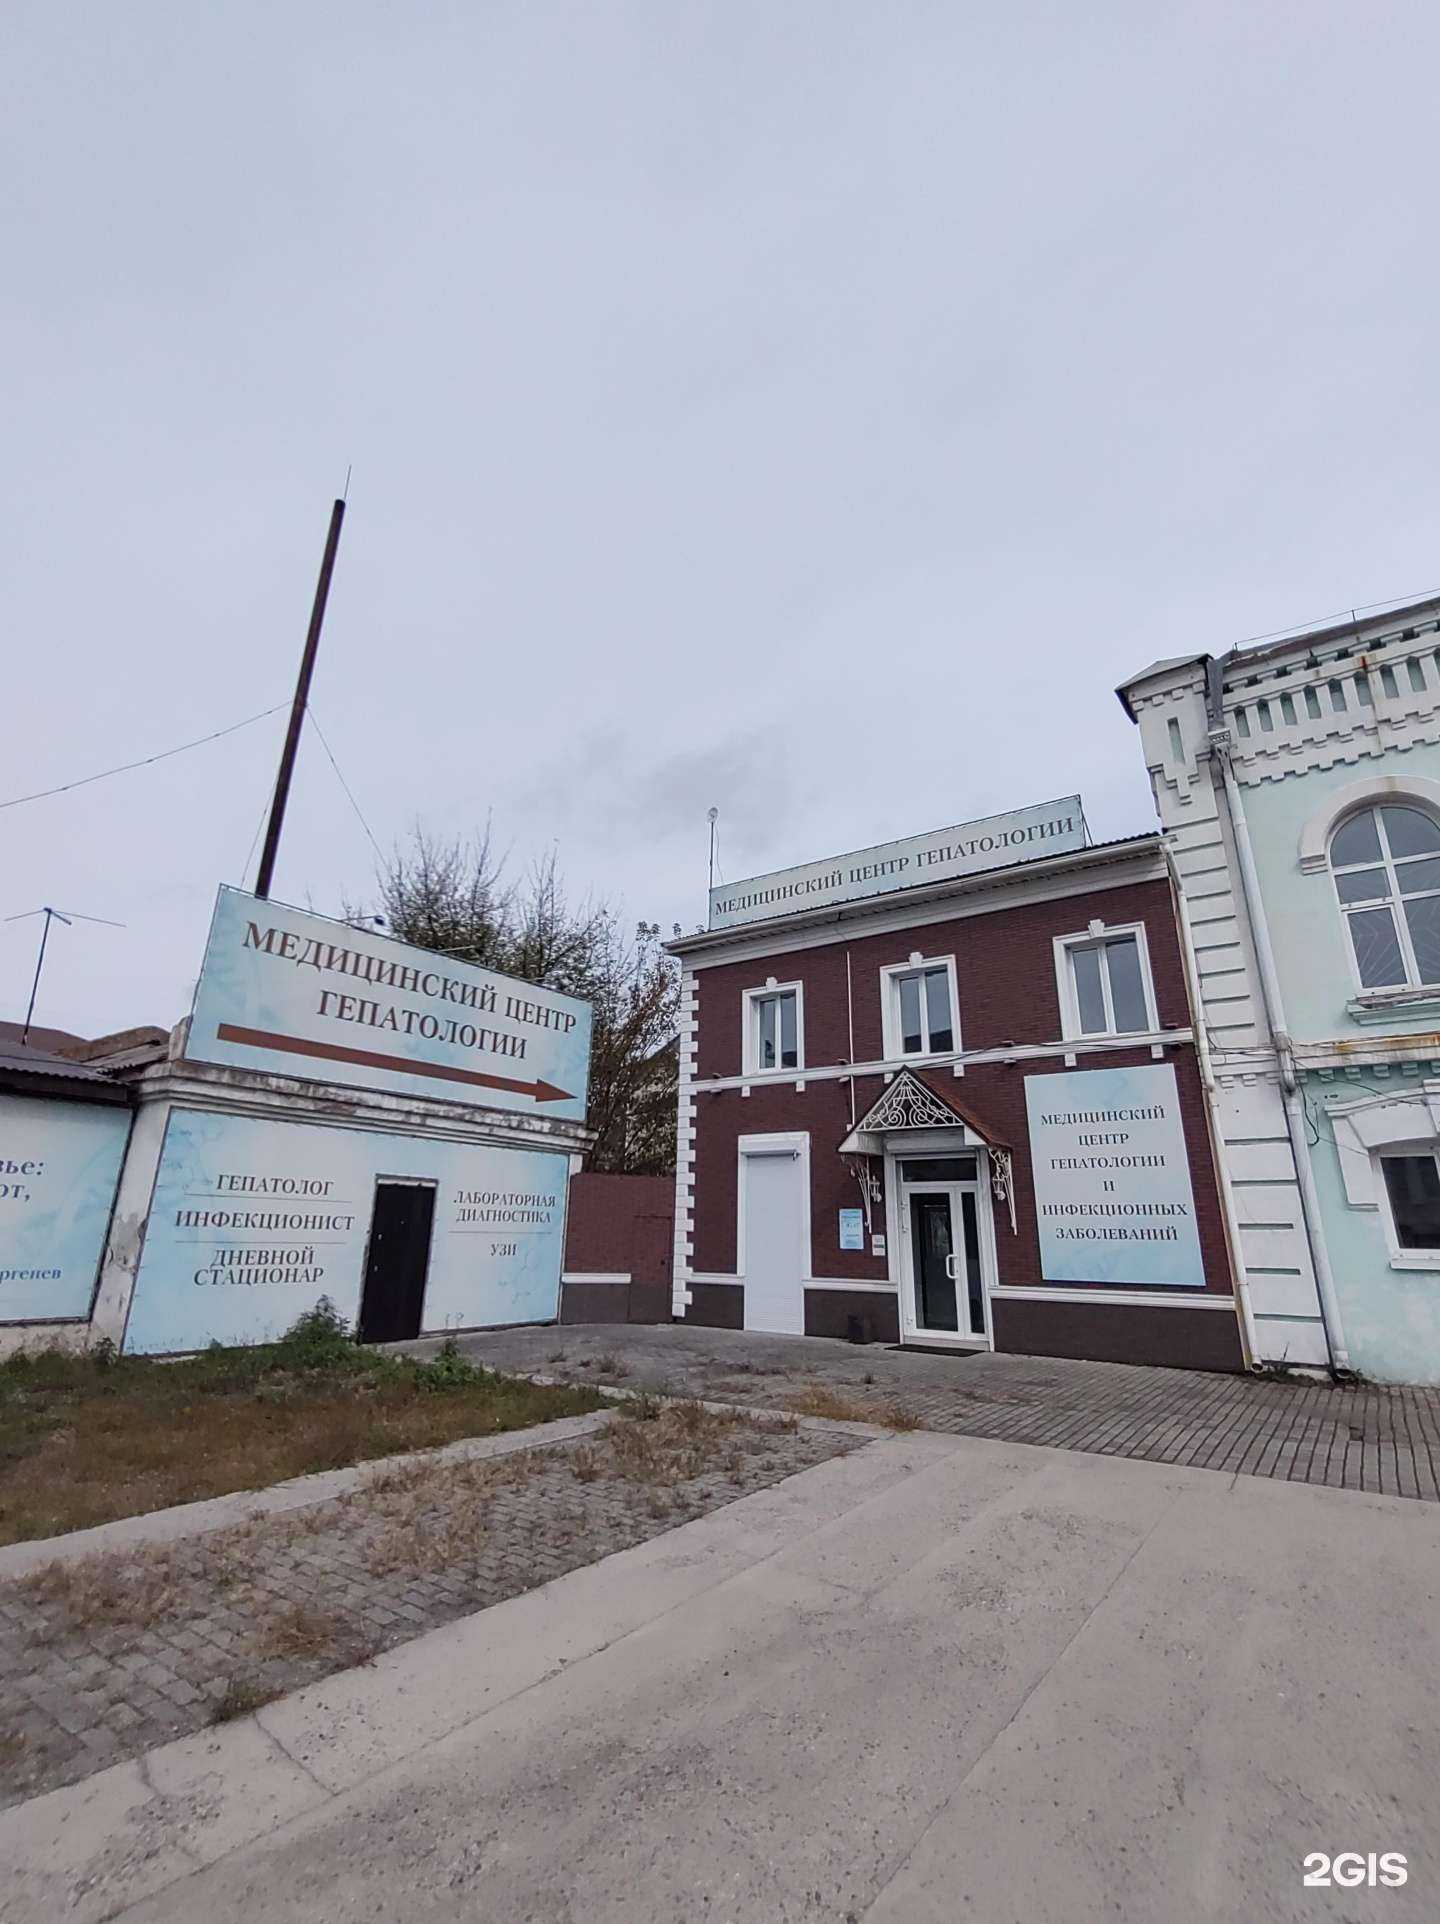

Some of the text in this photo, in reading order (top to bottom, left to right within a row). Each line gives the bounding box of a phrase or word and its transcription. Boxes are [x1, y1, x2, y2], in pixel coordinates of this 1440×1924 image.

[715, 816, 1074, 916] МЕДИЦИНСКИЙ ЦЕНТР ГЕПАТОЛОГИИ
[243, 920, 577, 1035] МЕДИЦИНСКИЙ ЦЕНТР
[316, 990, 528, 1060] ГЕПАТОЛОГИИ
[1041, 1105, 1165, 1126] МЕДИЦИНСКИЙ
[1078, 1133, 1129, 1147] ЦЕНТР
[1050, 1155, 1165, 1170] ГЕПАТОЛОГИИ
[216, 1174, 334, 1196] ГЕПАТОЛОГ
[1103, 1180, 1115, 1192] И
[453, 1190, 556, 1207] ЛАБОРАТОРНАЯ
[456, 1208, 551, 1223] ДИАГНОСТИКА
[1042, 1203, 1188, 1217] ИНФЕКЦИОННЫХ
[174, 1210, 355, 1231] ИНФЕКЦИОНИСТ
[1056, 1226, 1178, 1241] ЗАБОЛЕВАНИЙ
[210, 1246, 314, 1268] ДНЕВНОЙ
[490, 1243, 517, 1256] УЗИ
[194, 1267, 324, 1286] СТАЦИОНАР
